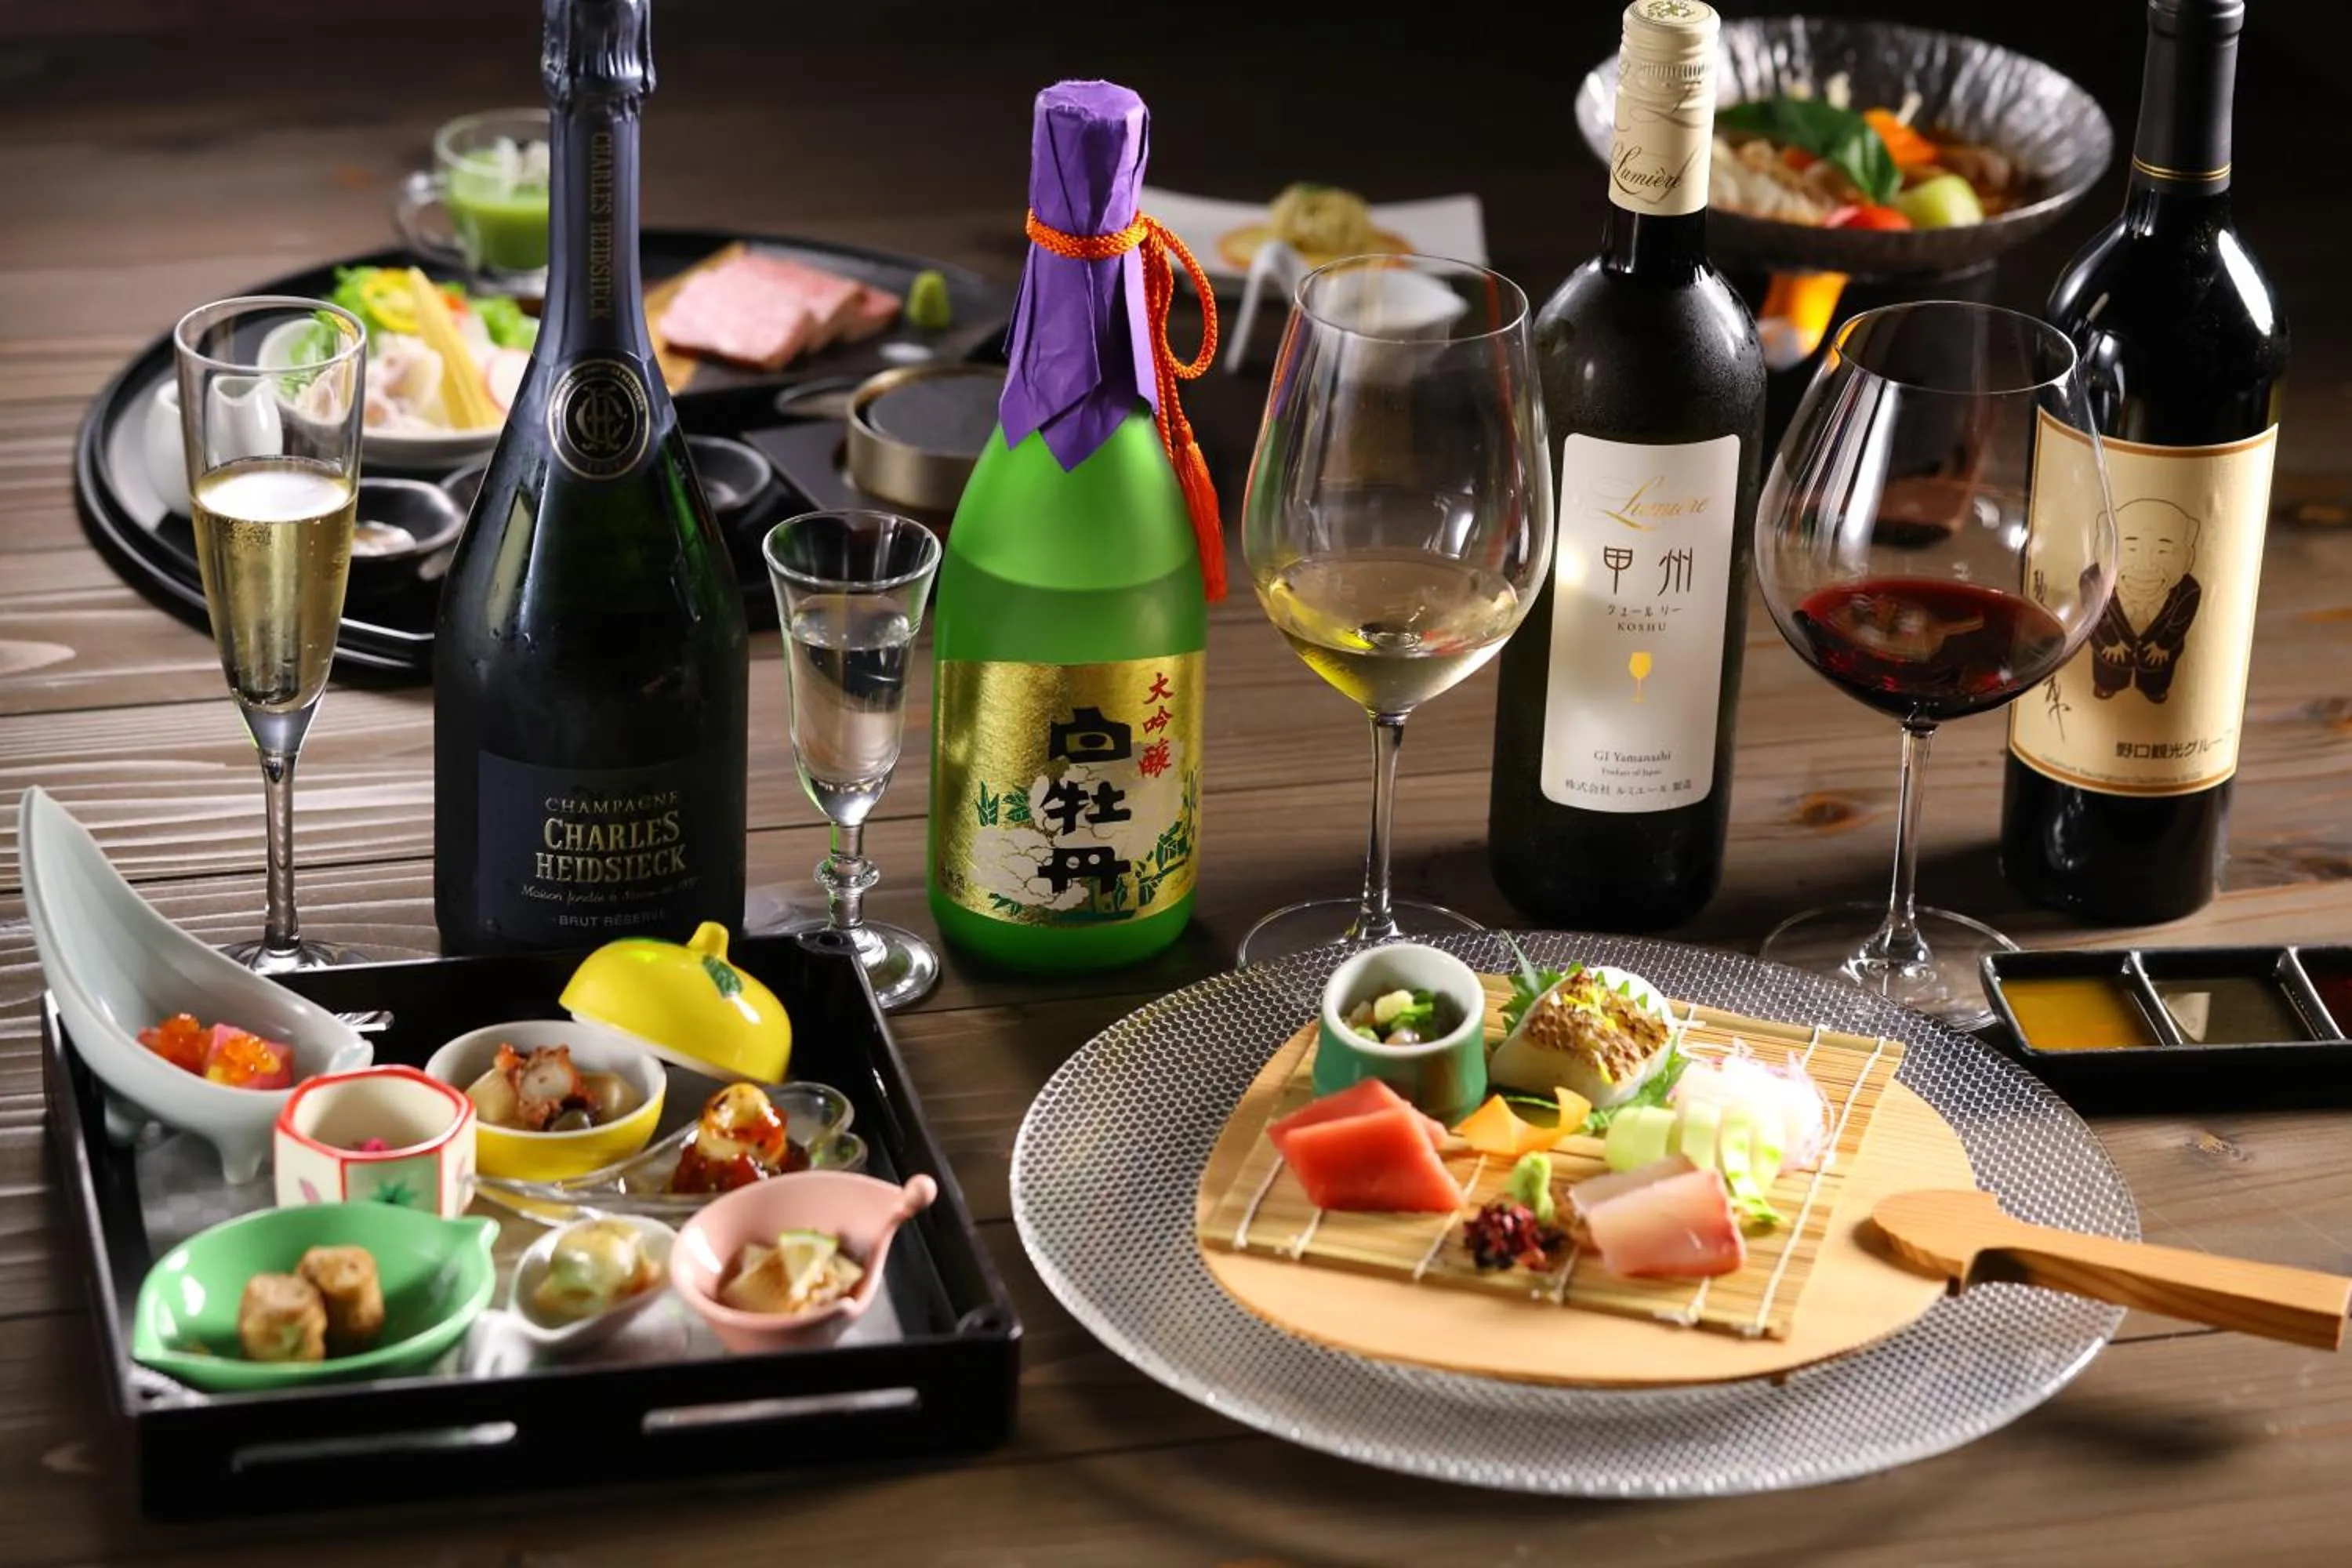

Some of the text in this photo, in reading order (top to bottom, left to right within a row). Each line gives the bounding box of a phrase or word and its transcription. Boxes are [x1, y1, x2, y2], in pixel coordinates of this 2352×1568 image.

[588, 131, 614, 320] CHARLES HEIDSIECK
[1603, 546, 1693, 596] 甲州
[1617, 621, 1667, 632] KOSHU
[1139, 672, 1174, 779] 大吟醸
[1614, 750, 1671, 763] Yamanashi
[544, 790, 680, 814] CHAMPAGNE
[1039, 707, 1131, 894] 白牡丹
[543, 809, 681, 852] CHARLES
[535, 843, 688, 884] HEIDSIECK
[558, 915, 599, 927] BRUT
